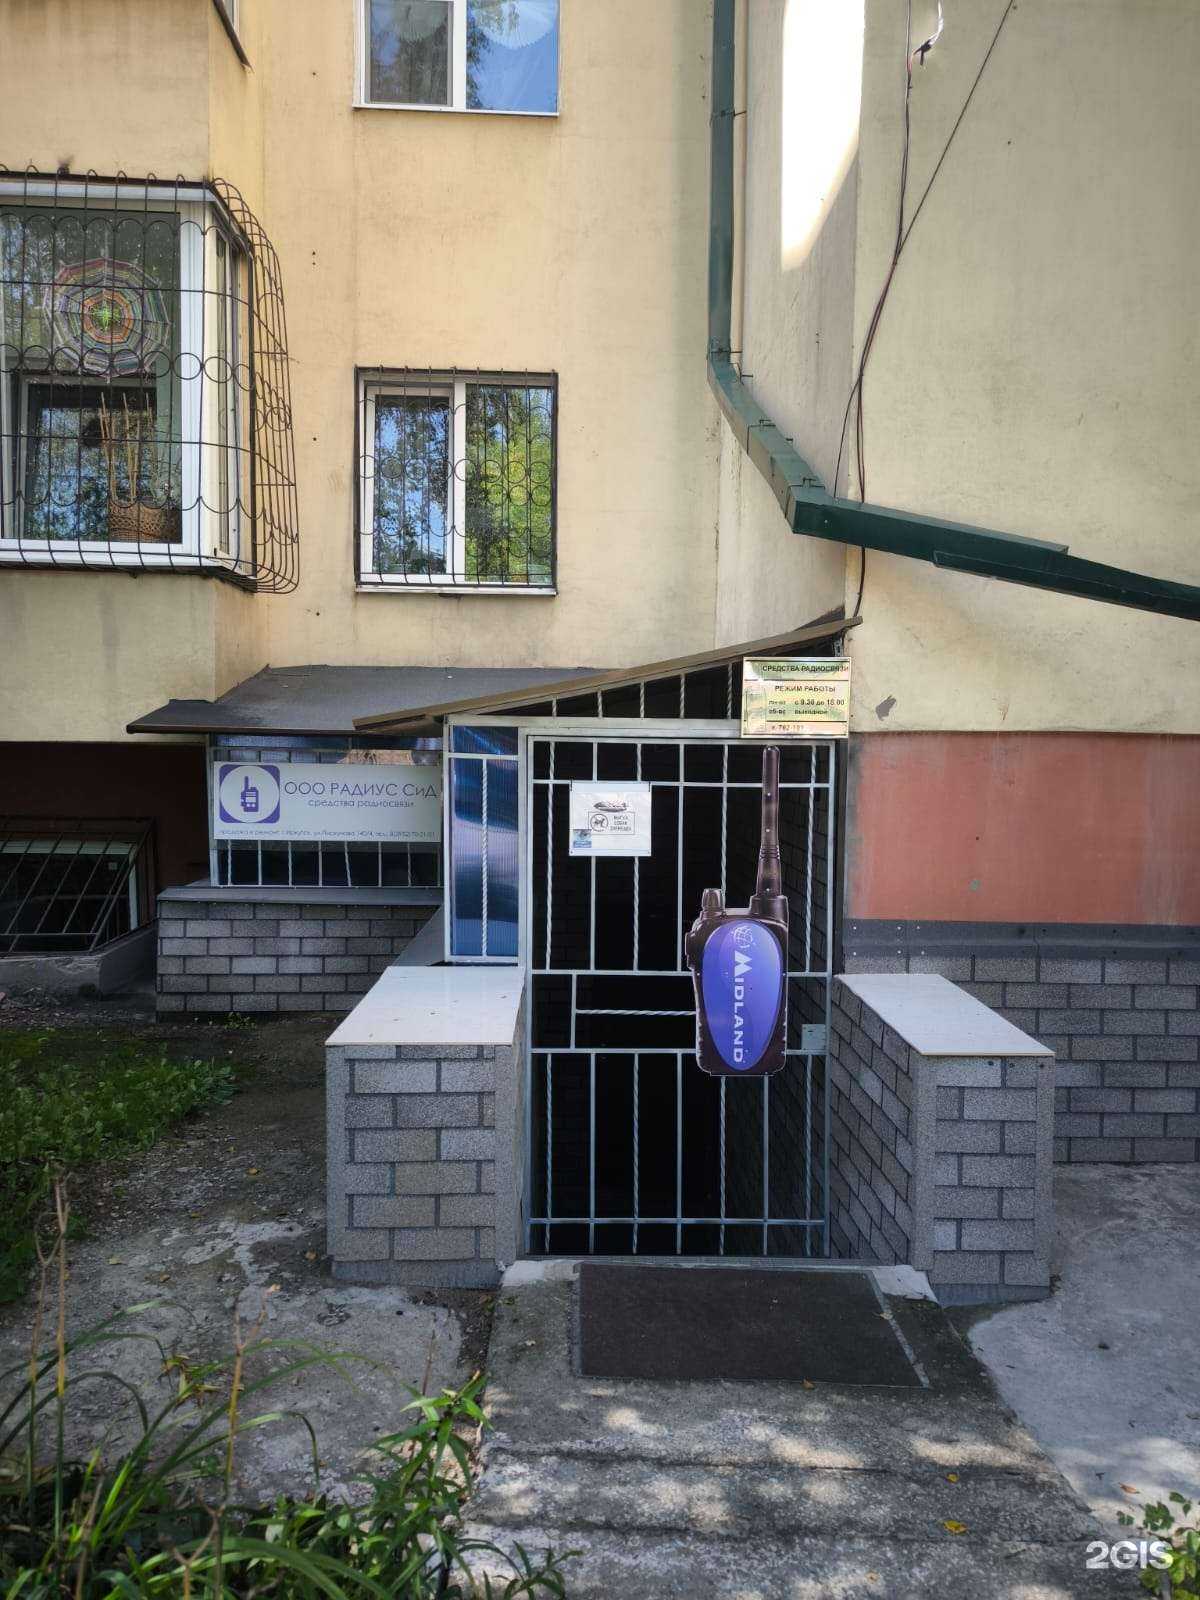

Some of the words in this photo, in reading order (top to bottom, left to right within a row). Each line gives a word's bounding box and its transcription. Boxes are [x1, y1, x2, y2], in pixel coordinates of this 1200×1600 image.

[801, 665, 849, 673] РАДИОСВЯЗИ
[284, 781, 326, 795] ООО
[330, 782, 398, 796] РАДИУС
[402, 783, 437, 798] СиД
[308, 800, 355, 808] средства
[733, 950, 753, 1063] MIDLAND
